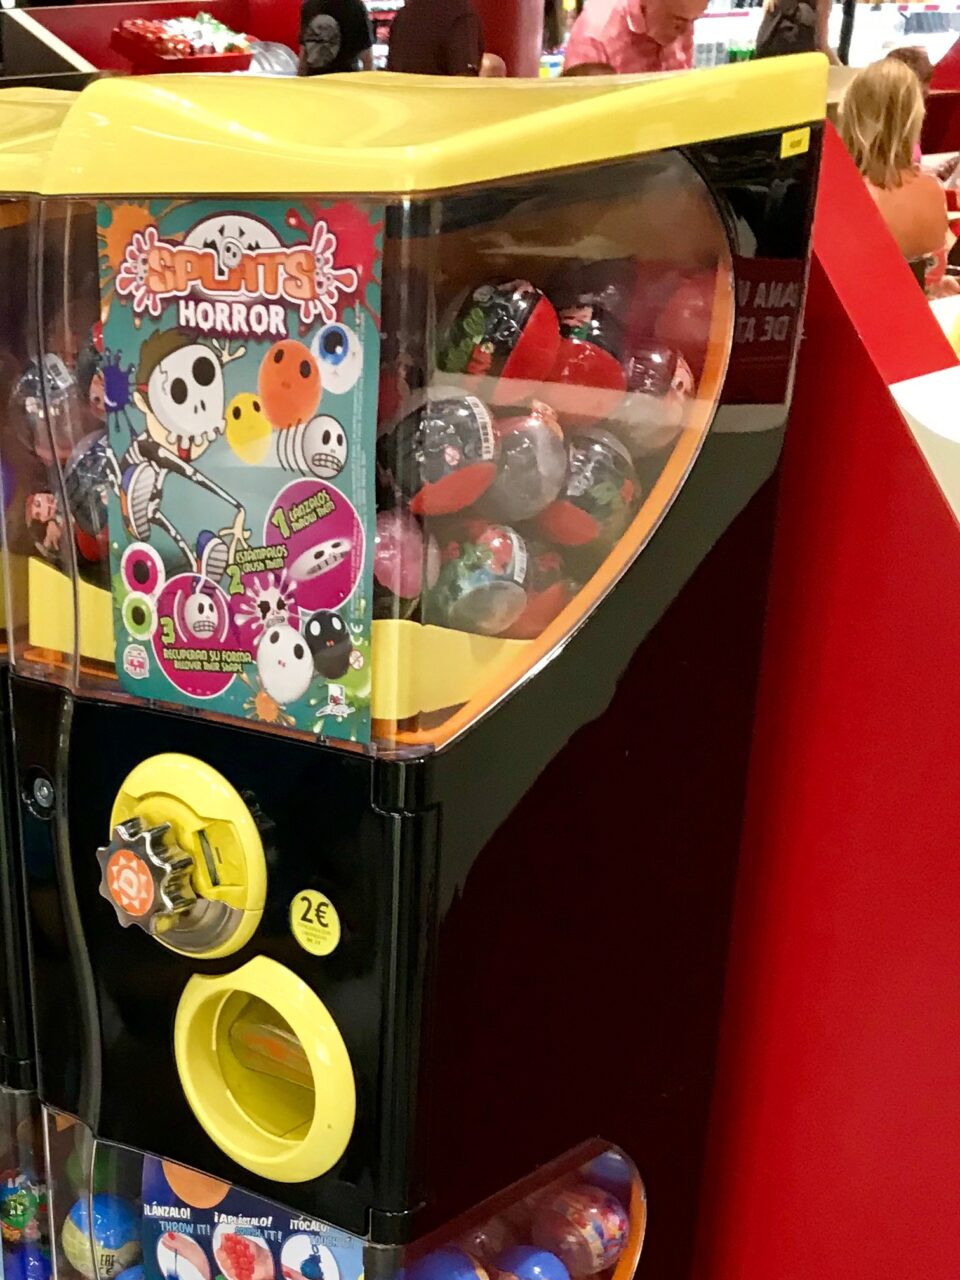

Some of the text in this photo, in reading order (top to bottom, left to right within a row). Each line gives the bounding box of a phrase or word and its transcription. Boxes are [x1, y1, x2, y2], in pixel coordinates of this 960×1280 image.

[179, 300, 287, 336] HORROR
[272, 507, 291, 539] 1
[226, 564, 245, 595] 2
[160, 616, 176, 645] 3
[300, 895, 329, 928] 2€
[143, 1201, 191, 1220] ¡LÁNZALO!
[159, 1220, 194, 1234] THROW
[263, 1229, 283, 1243] IT!
